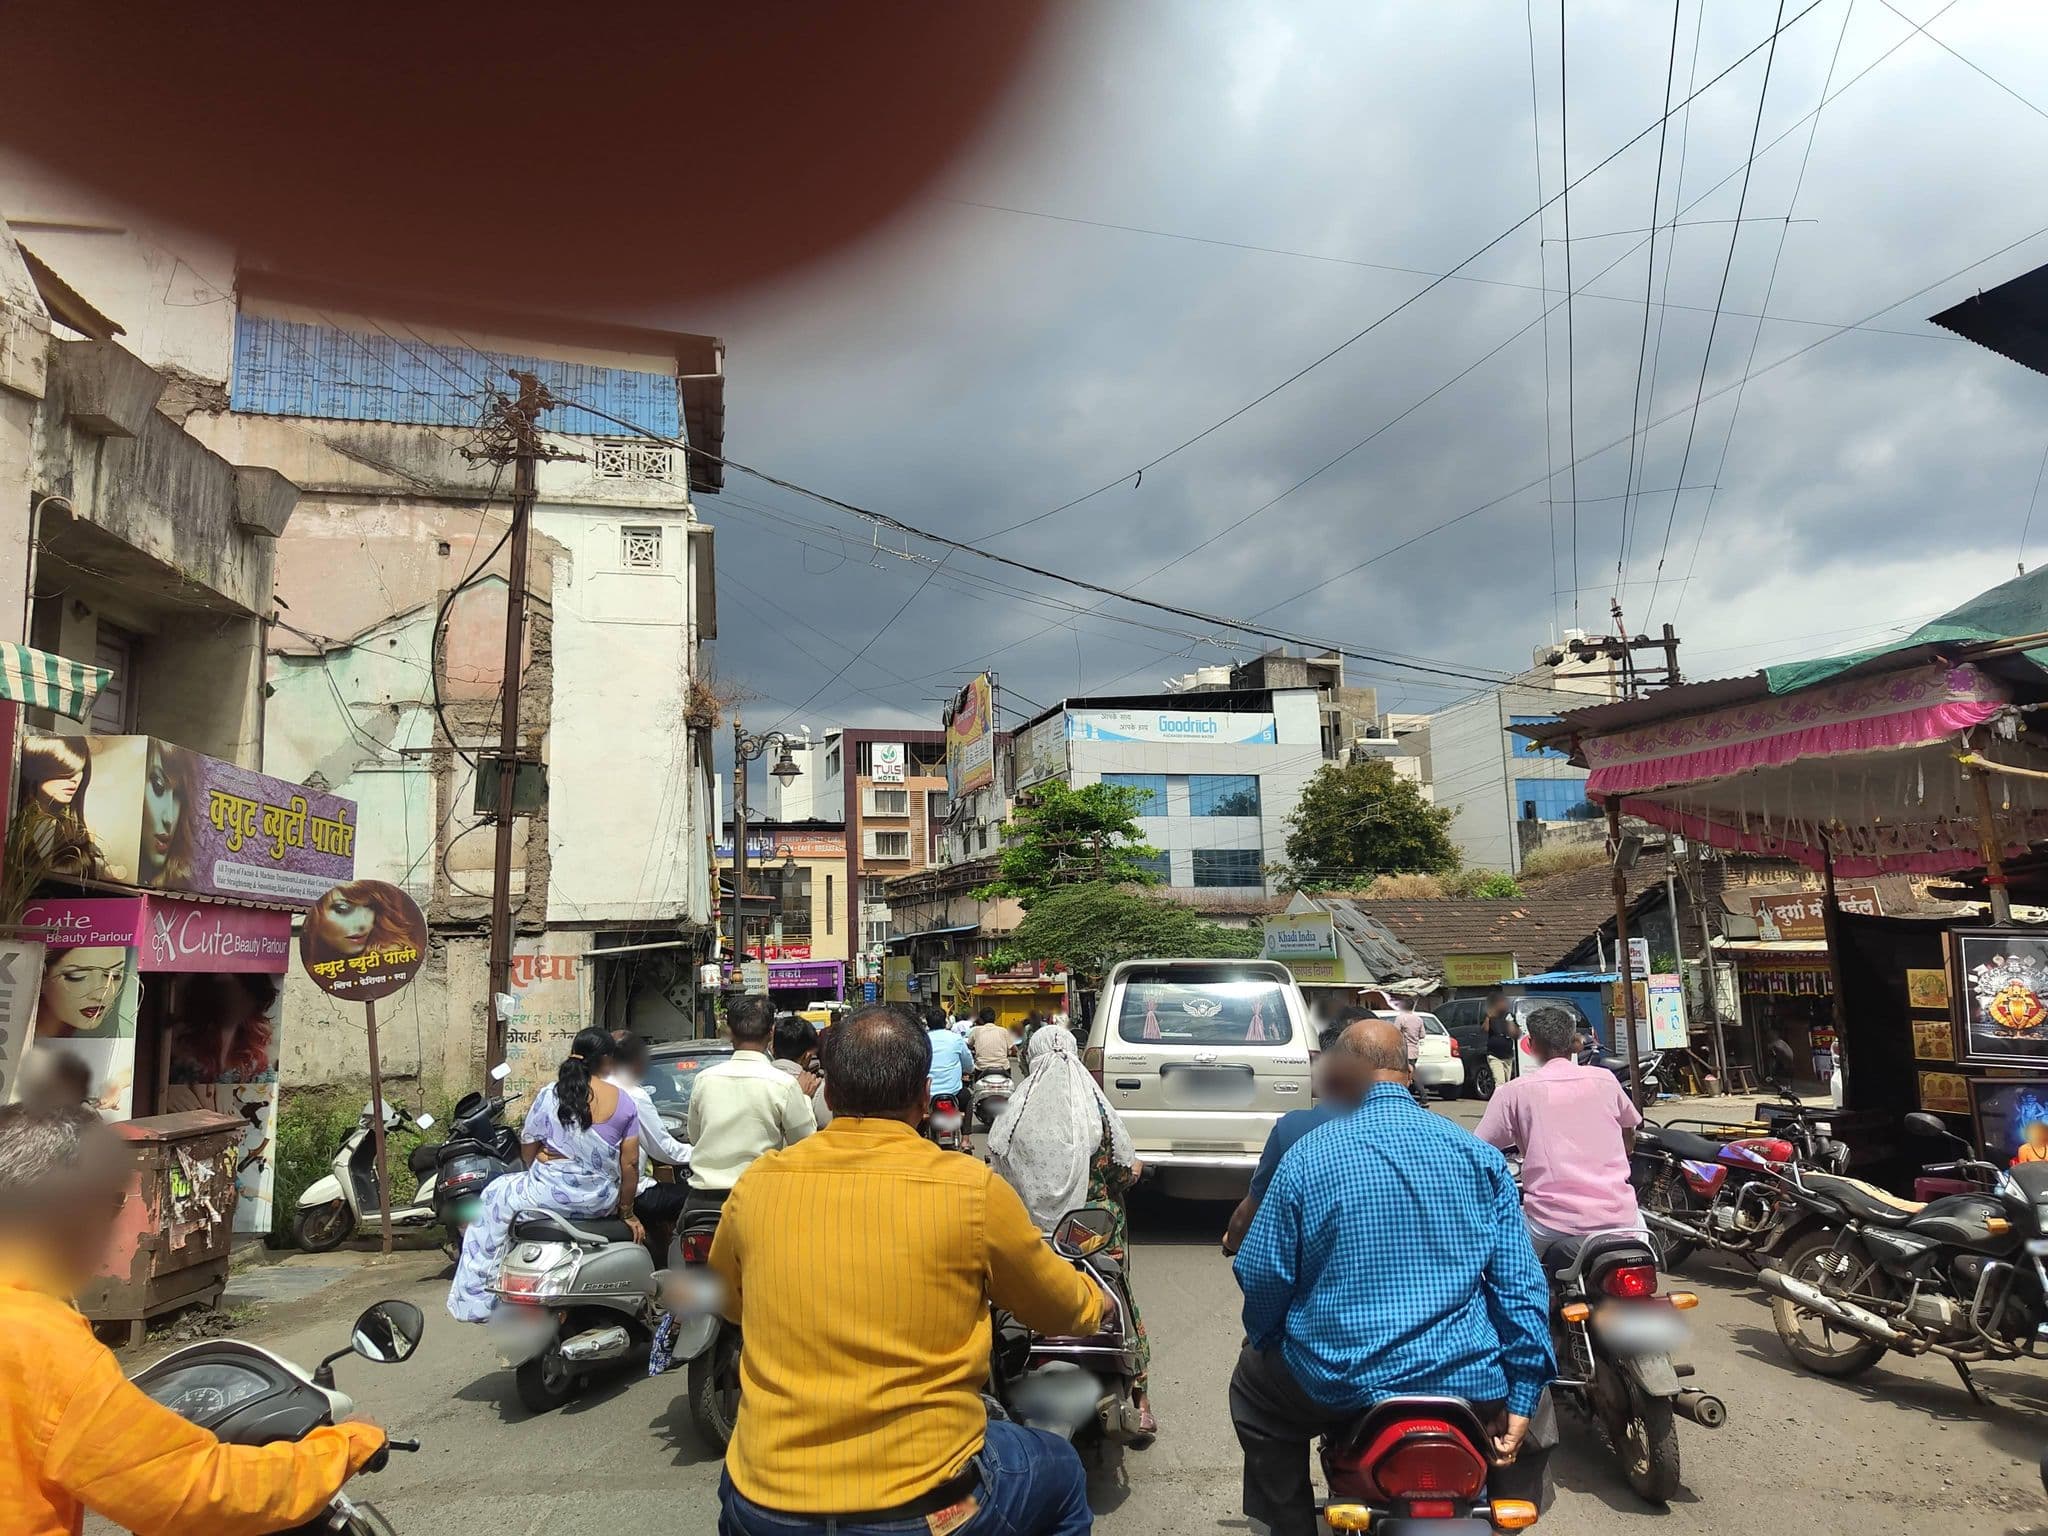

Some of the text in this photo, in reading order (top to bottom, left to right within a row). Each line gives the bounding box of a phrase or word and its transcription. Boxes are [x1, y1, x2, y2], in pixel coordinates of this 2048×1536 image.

[209, 789, 354, 860] क्युट ब्युटी पार्लर
[20, 907, 93, 933] Cute
[179, 910, 288, 957] Cute Beauty Parlour
[46, 931, 134, 944] Beauty Parlour
[1277, 929, 1317, 943] Khadi India
[313, 945, 418, 979] क्युट ब्युटी पार्लर
